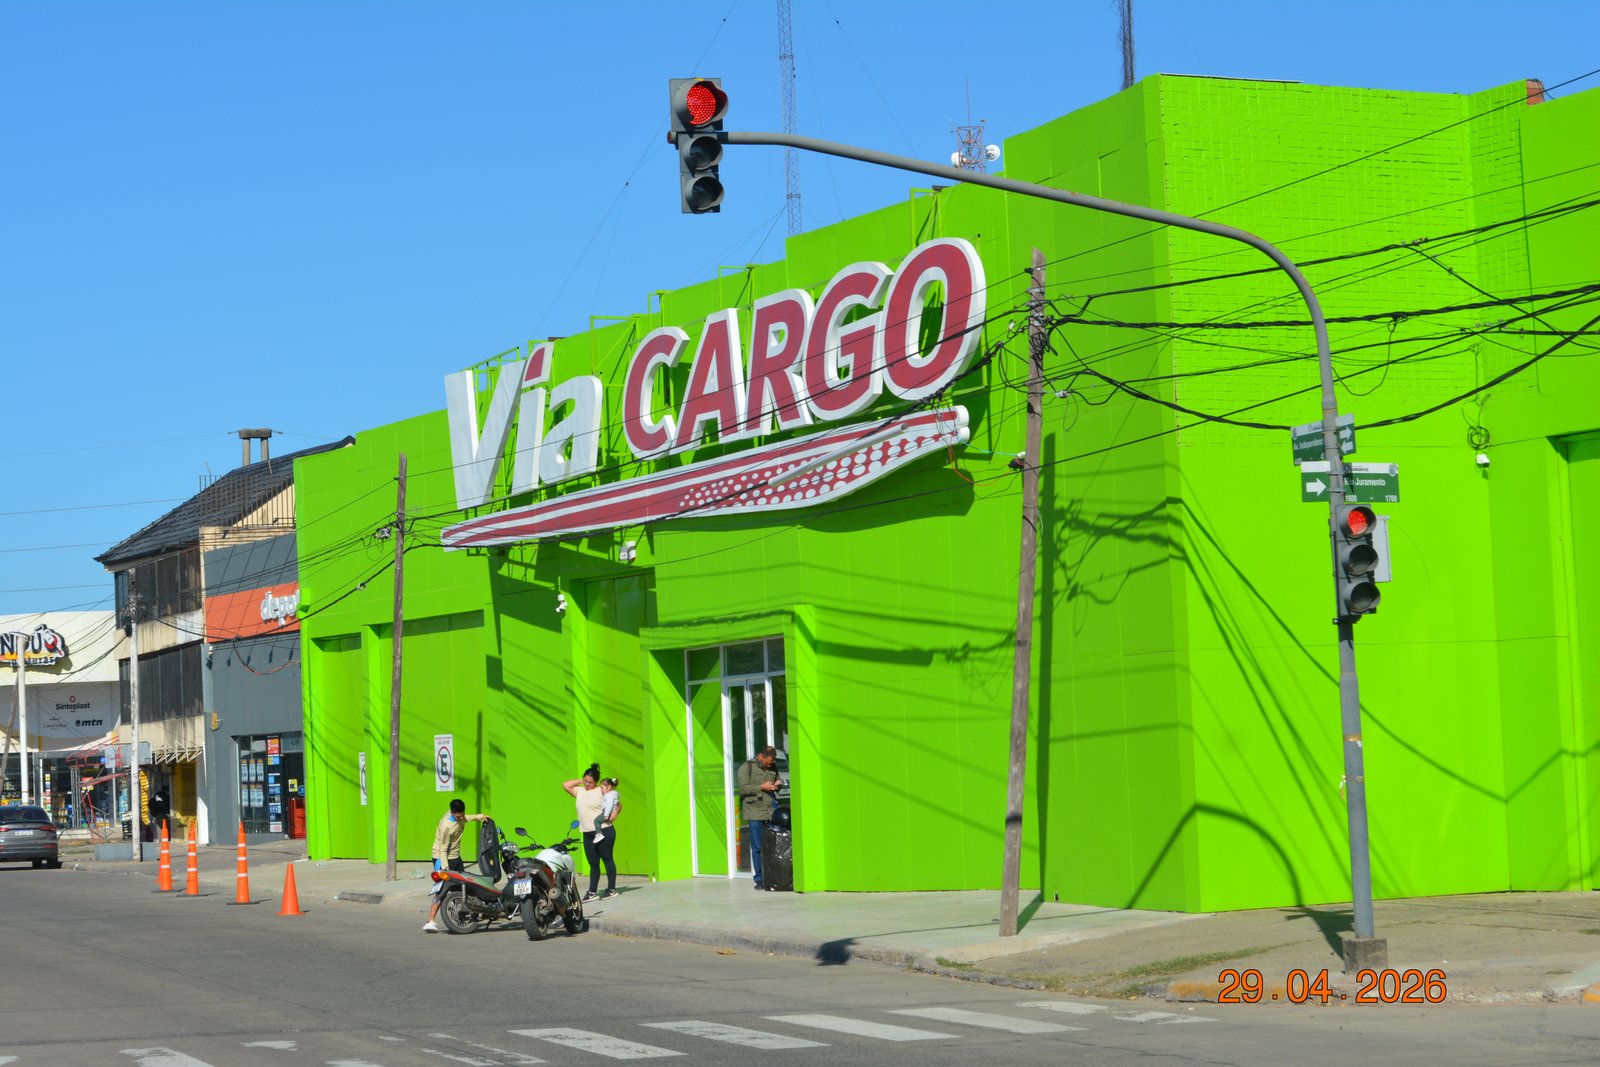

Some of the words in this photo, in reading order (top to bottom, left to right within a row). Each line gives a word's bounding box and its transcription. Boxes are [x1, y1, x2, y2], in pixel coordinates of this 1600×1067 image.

[443, 341, 603, 510] Via
[622, 236, 988, 461] CARGO
[1299, 438, 1324, 450] Independenc
[1355, 477, 1386, 487] Juramento
[55, 702, 90, 711] Sinteplast
[81, 719, 103, 727] mtn
